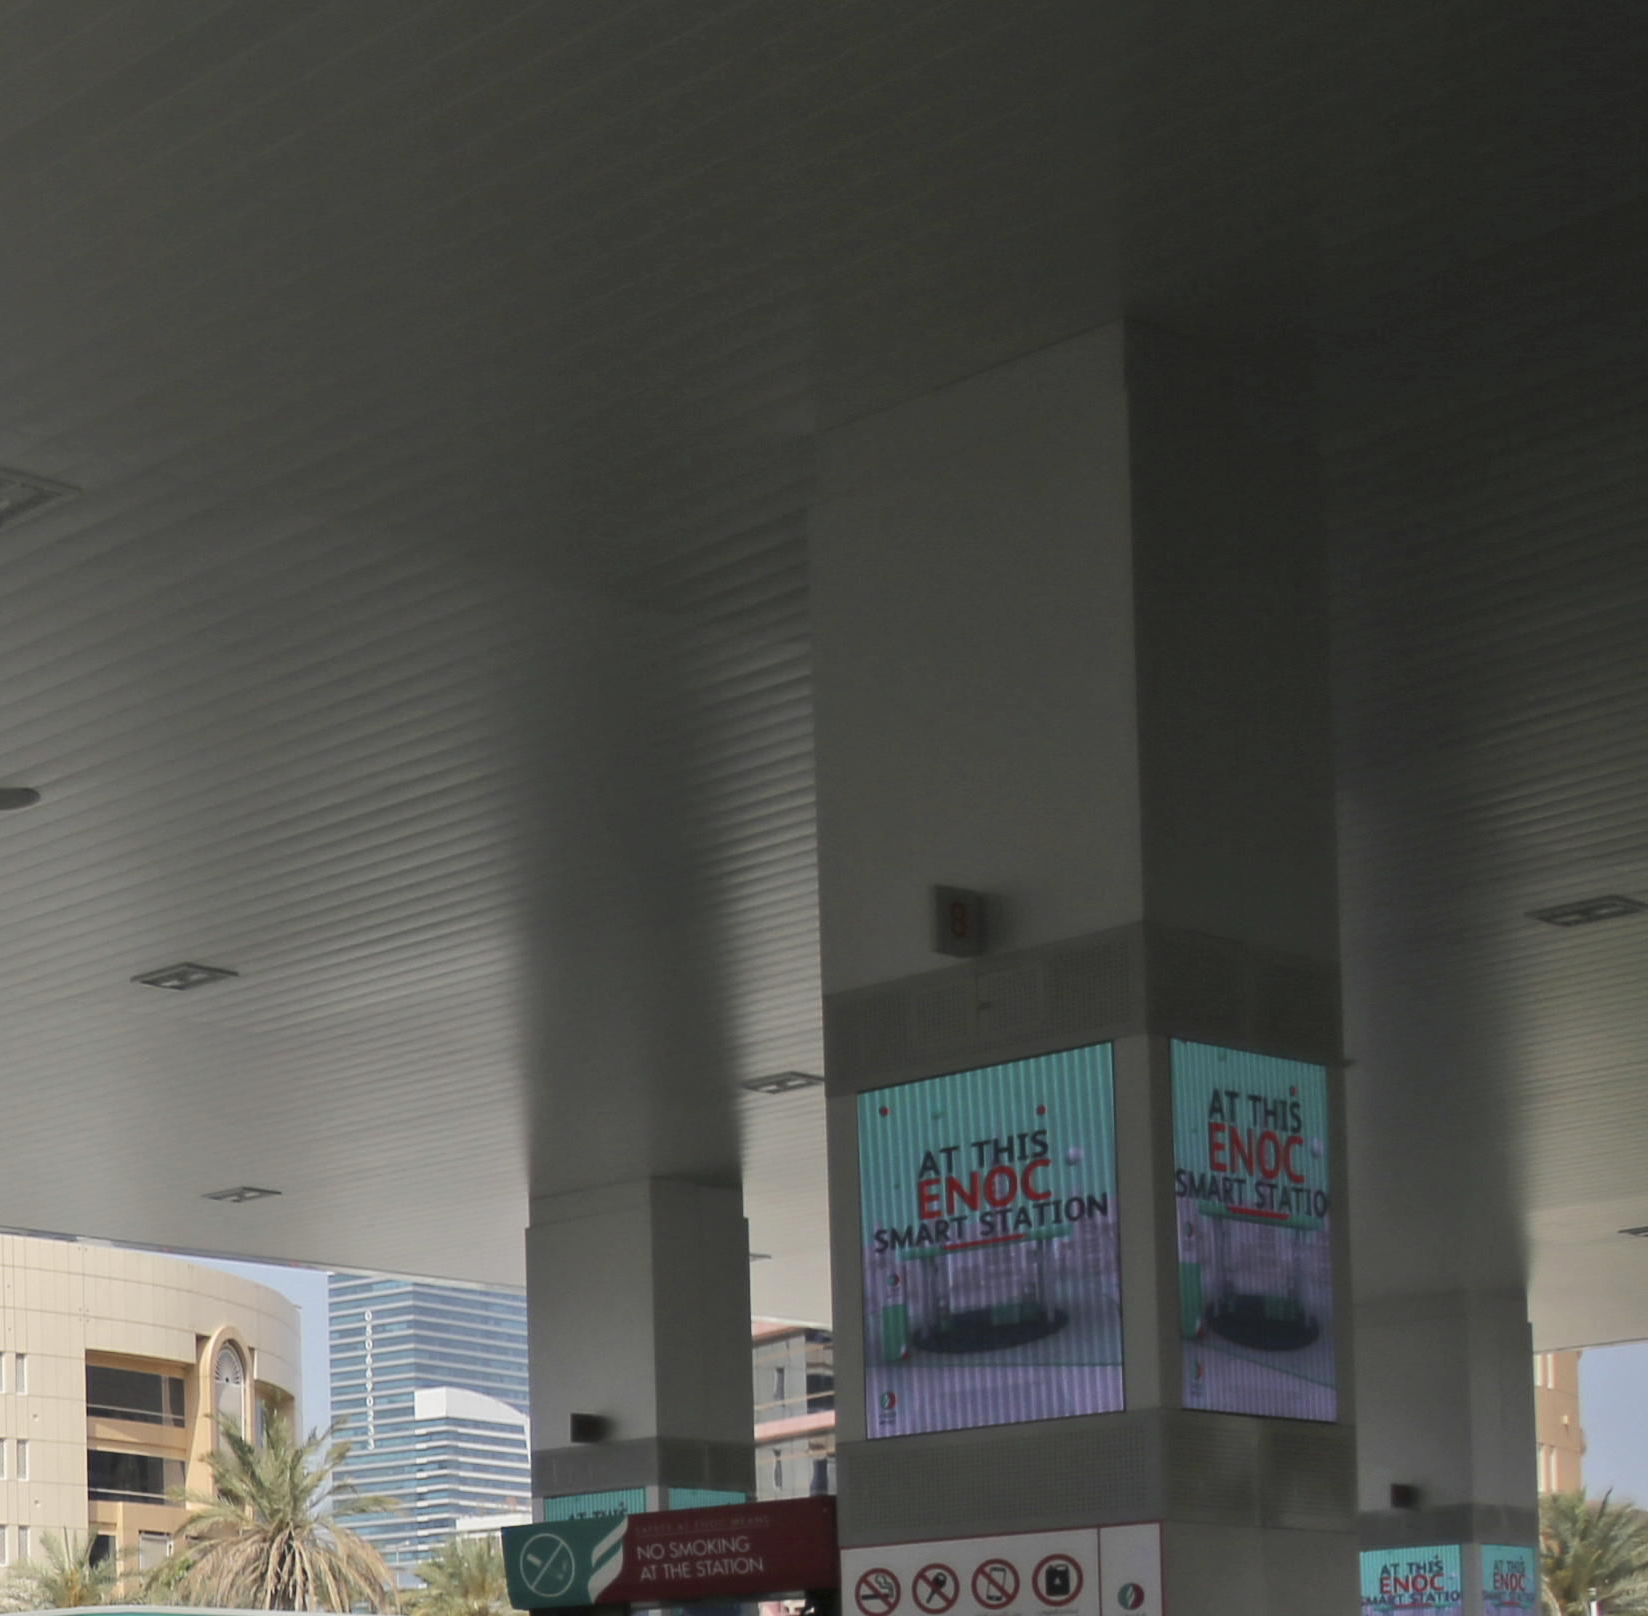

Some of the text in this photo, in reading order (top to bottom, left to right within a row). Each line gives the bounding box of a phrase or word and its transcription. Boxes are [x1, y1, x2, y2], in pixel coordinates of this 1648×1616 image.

[1209, 1088, 1303, 1135] AT THIS
[918, 1129, 1050, 1178] AT THIS
[1208, 1121, 1305, 1185] ENOC
[917, 1158, 1052, 1220] ENOC
[1174, 1167, 1245, 1207] SMART
[873, 1191, 1110, 1254] SMART STATION
[637, 1535, 751, 1561] NO SMOKING
[1380, 1560, 1444, 1576] AT THIS
[640, 1556, 765, 1582] AT THE STATION
[1379, 1572, 1445, 1596] ENOC
[1493, 1572, 1527, 1592] ENOC
